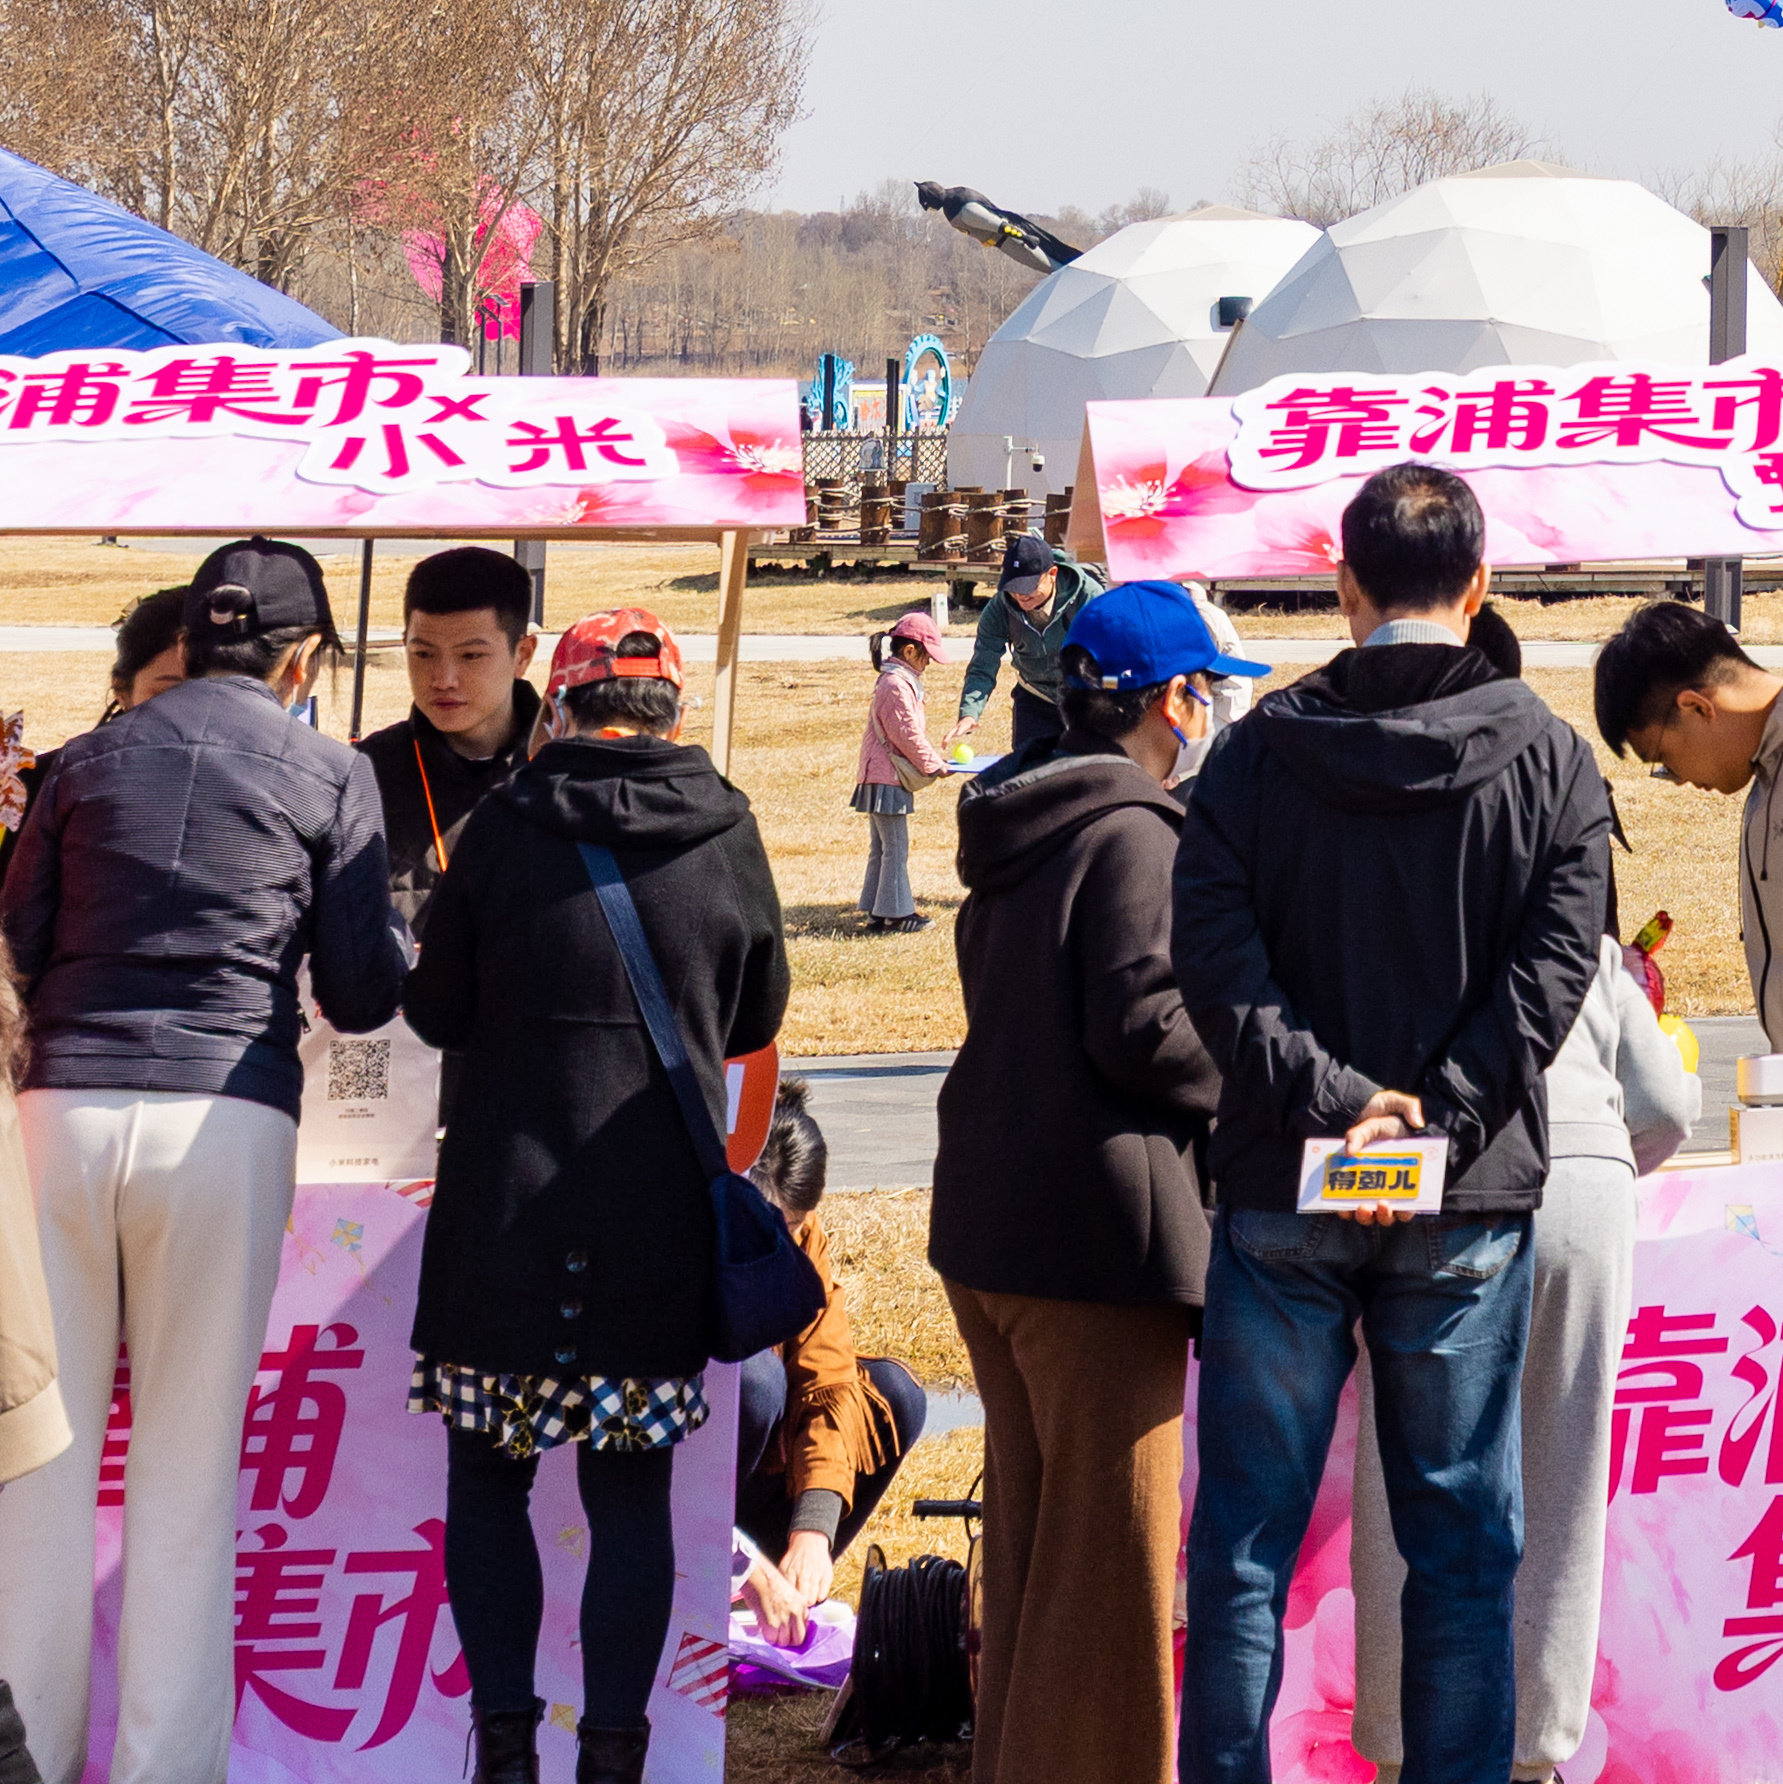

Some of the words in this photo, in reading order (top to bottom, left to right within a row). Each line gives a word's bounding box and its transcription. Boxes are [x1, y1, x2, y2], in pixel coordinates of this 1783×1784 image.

[328, 416, 648, 480] 小米
[1328, 1169, 1418, 1192] 得劲儿
